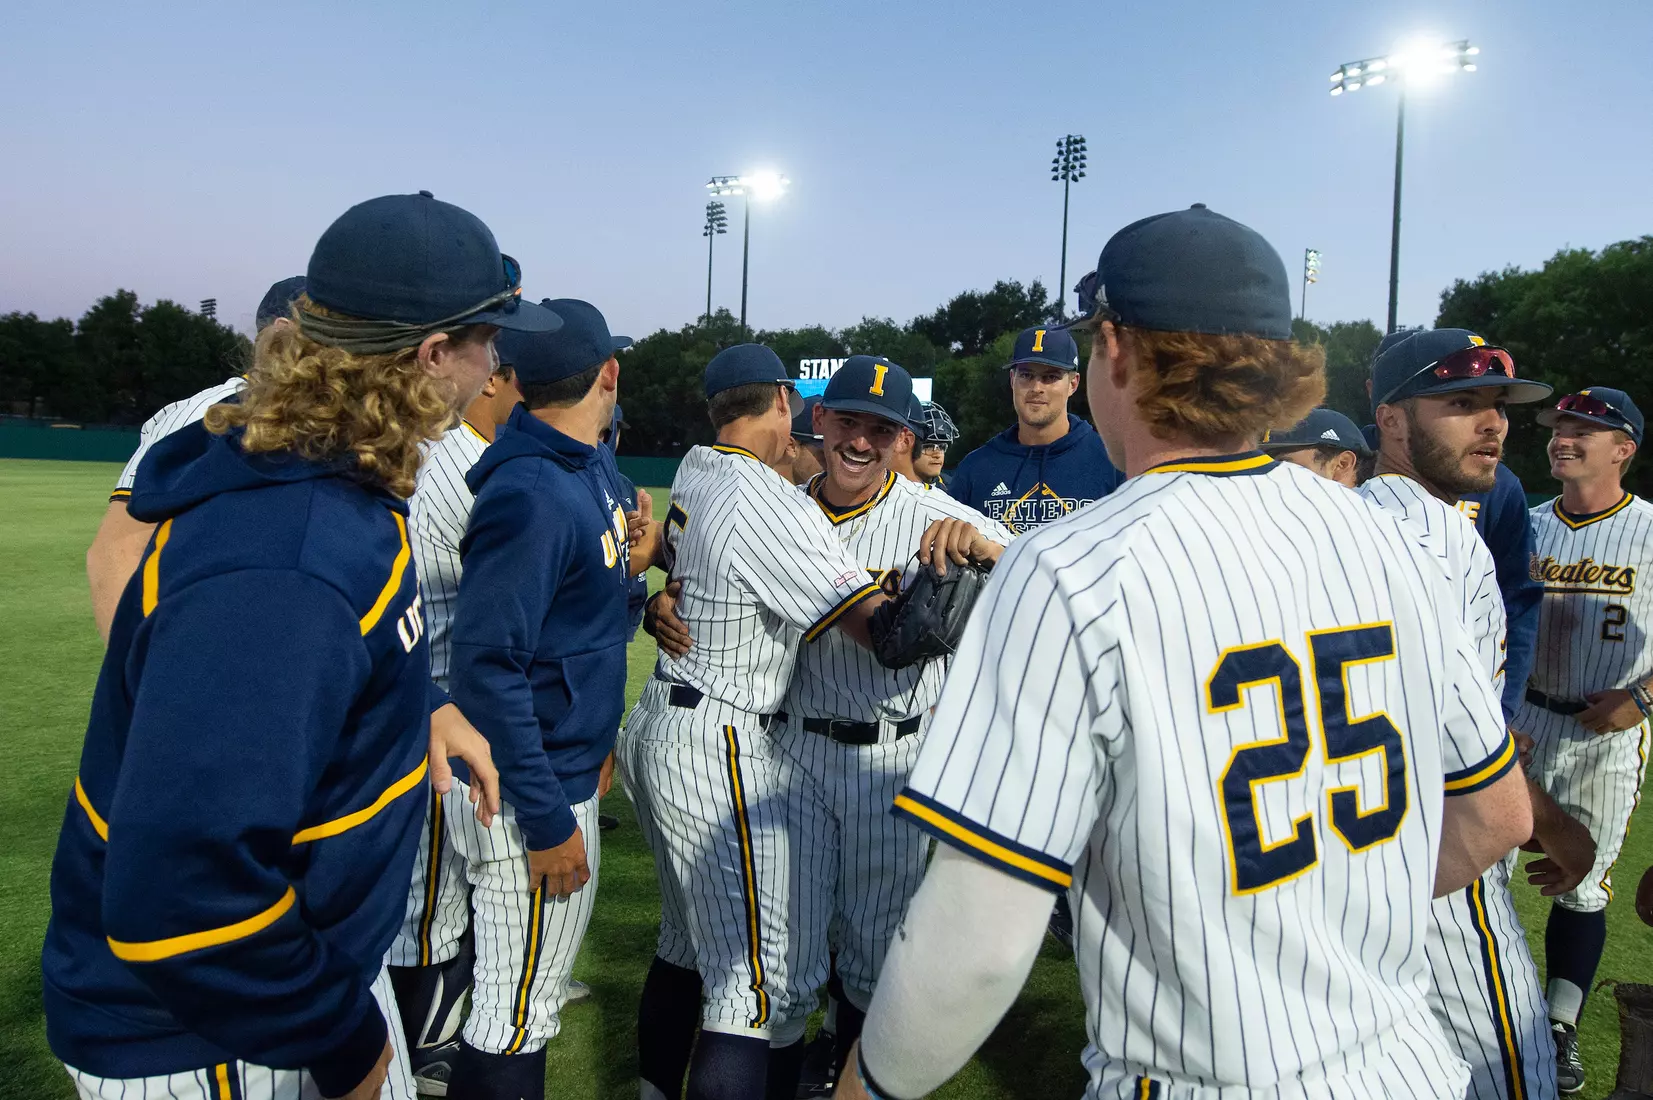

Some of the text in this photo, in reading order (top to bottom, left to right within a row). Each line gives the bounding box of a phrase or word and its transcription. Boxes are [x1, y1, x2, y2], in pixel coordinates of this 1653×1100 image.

[1032, 329, 1047, 353] I
[799, 357, 849, 380] STAN
[869, 363, 889, 397] I
[1529, 553, 1636, 595] teaters
[1602, 603, 1627, 641] 2
[1204, 620, 1411, 897] 25
